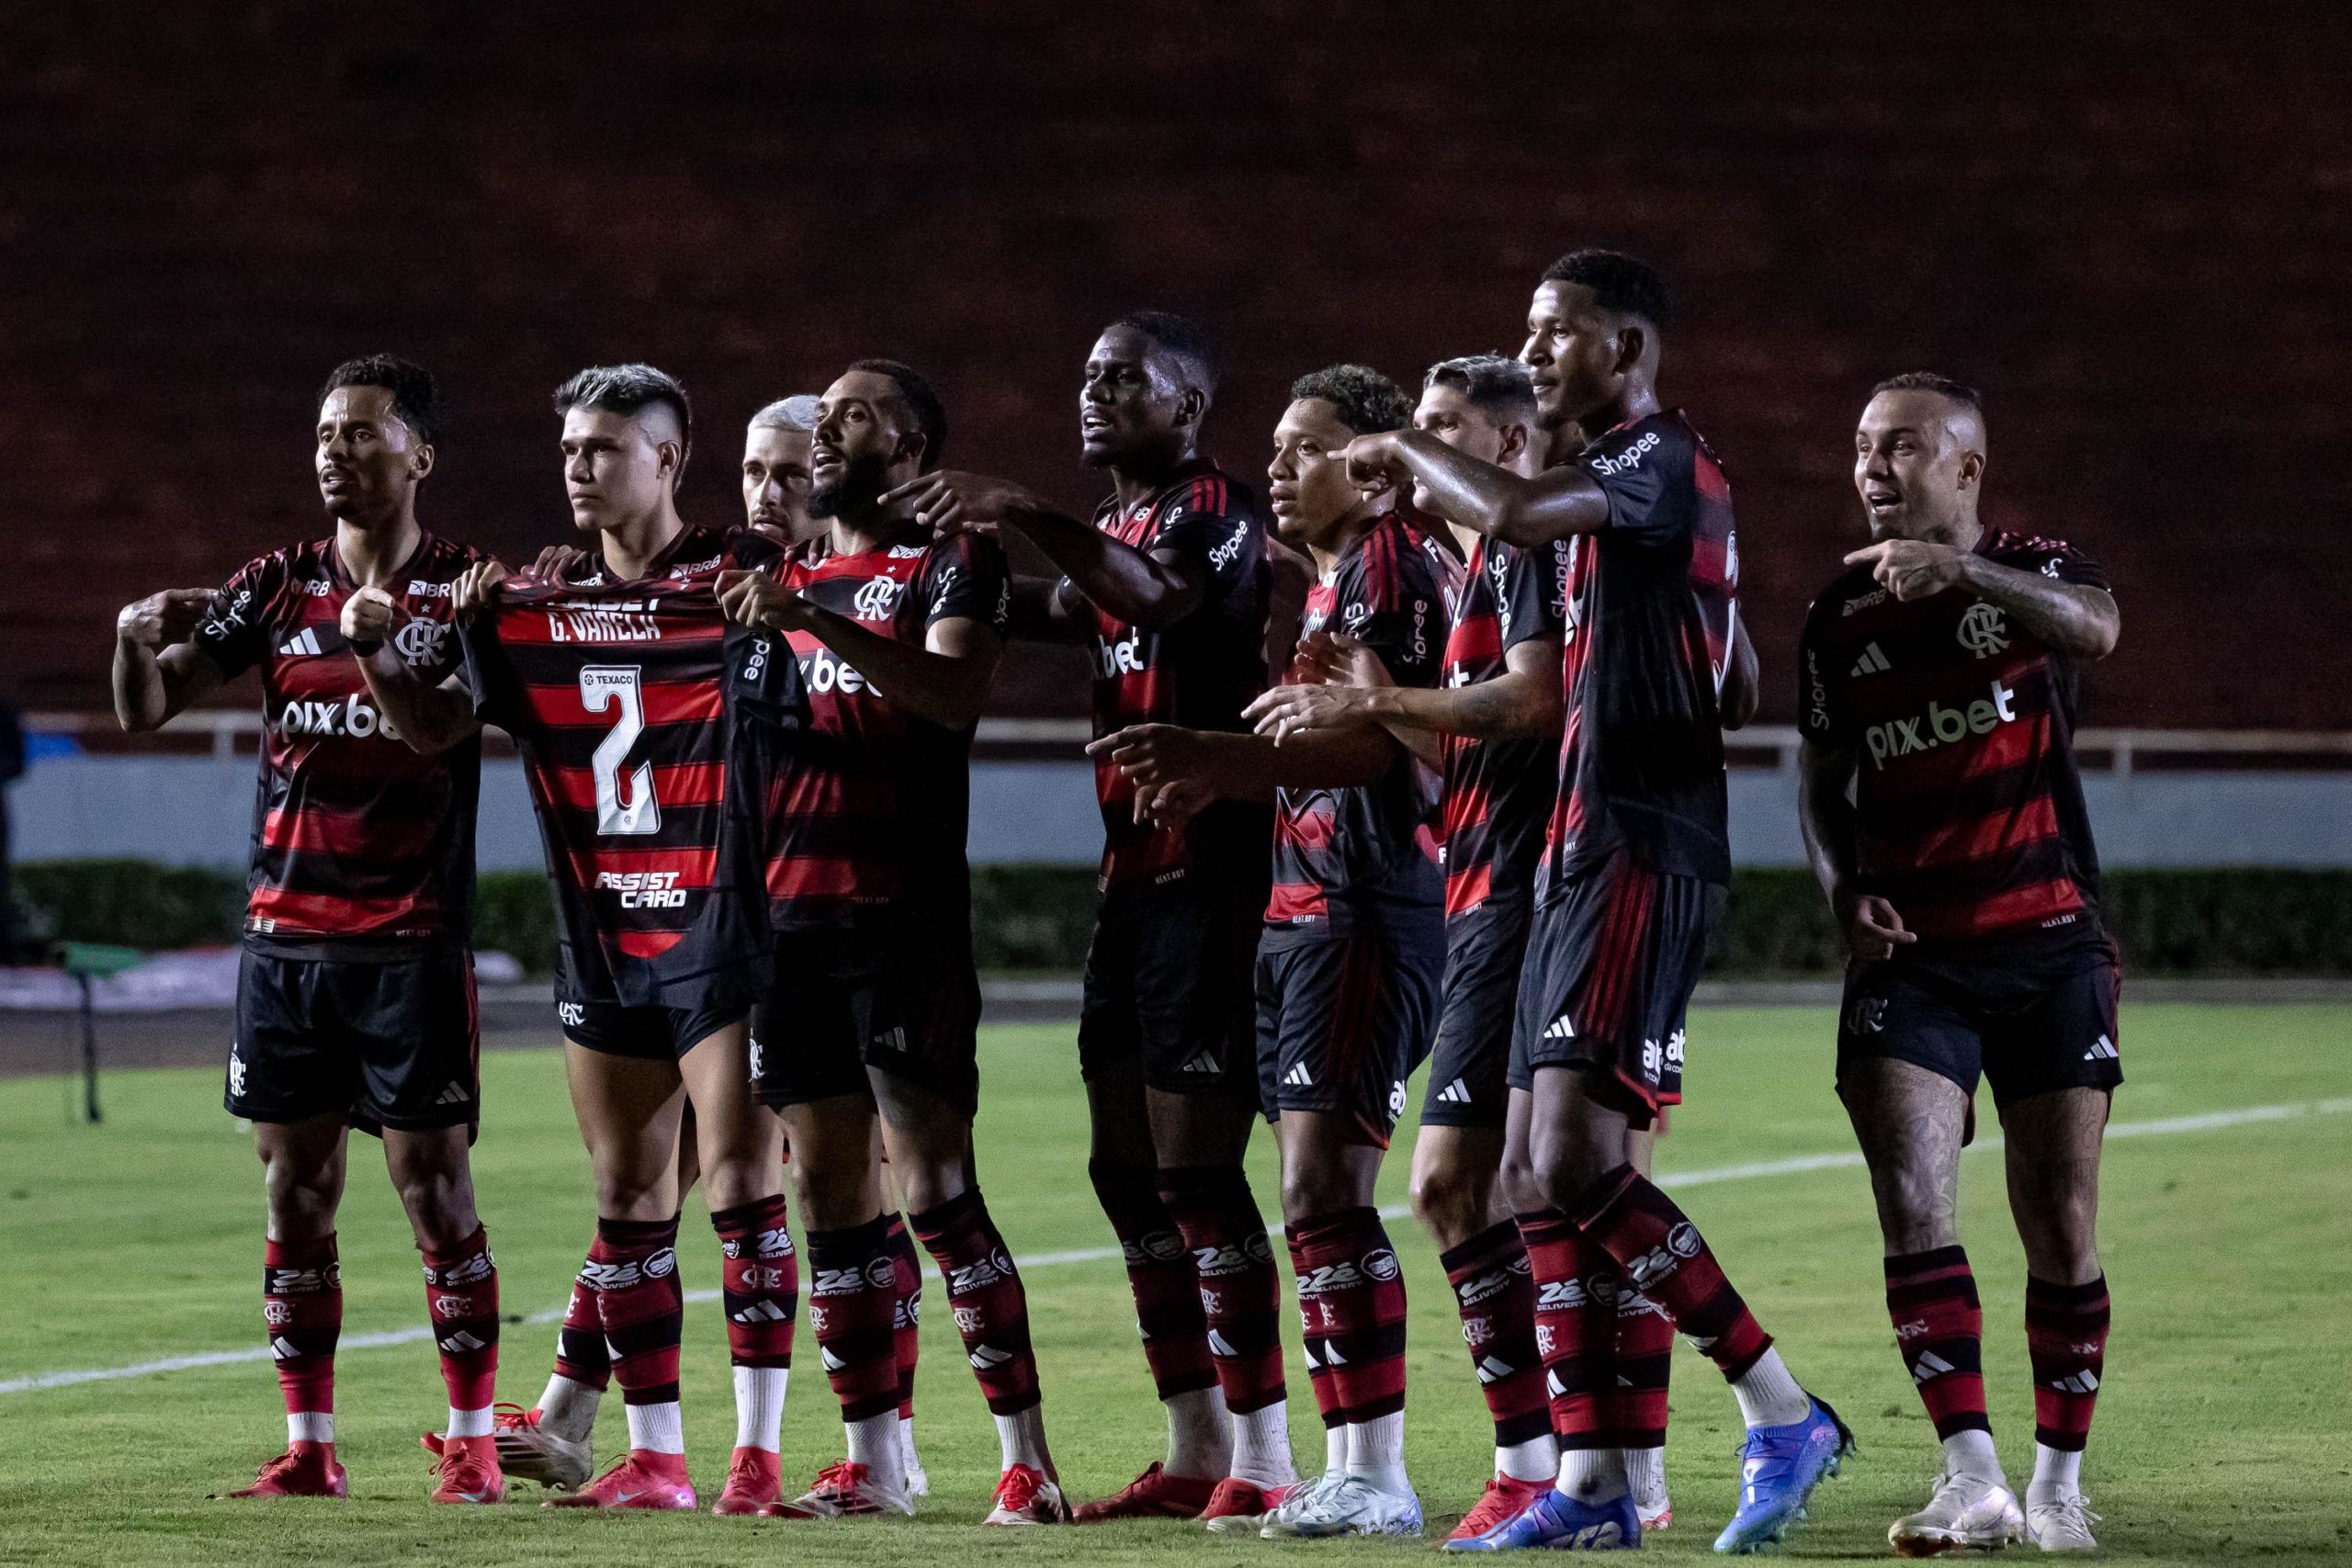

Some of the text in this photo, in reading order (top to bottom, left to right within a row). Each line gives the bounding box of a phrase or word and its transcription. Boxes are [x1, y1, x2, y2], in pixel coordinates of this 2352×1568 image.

[1591, 432, 1660, 476] Shopee
[1209, 520, 1248, 571] Shopee
[425, 583, 452, 598] BR
[1550, 539, 1567, 618] Shopee
[596, 675, 632, 685] TEXACO
[1865, 680, 2016, 771] pix.bet
[580, 664, 662, 835] 2
[594, 871, 680, 890] ASSIST
